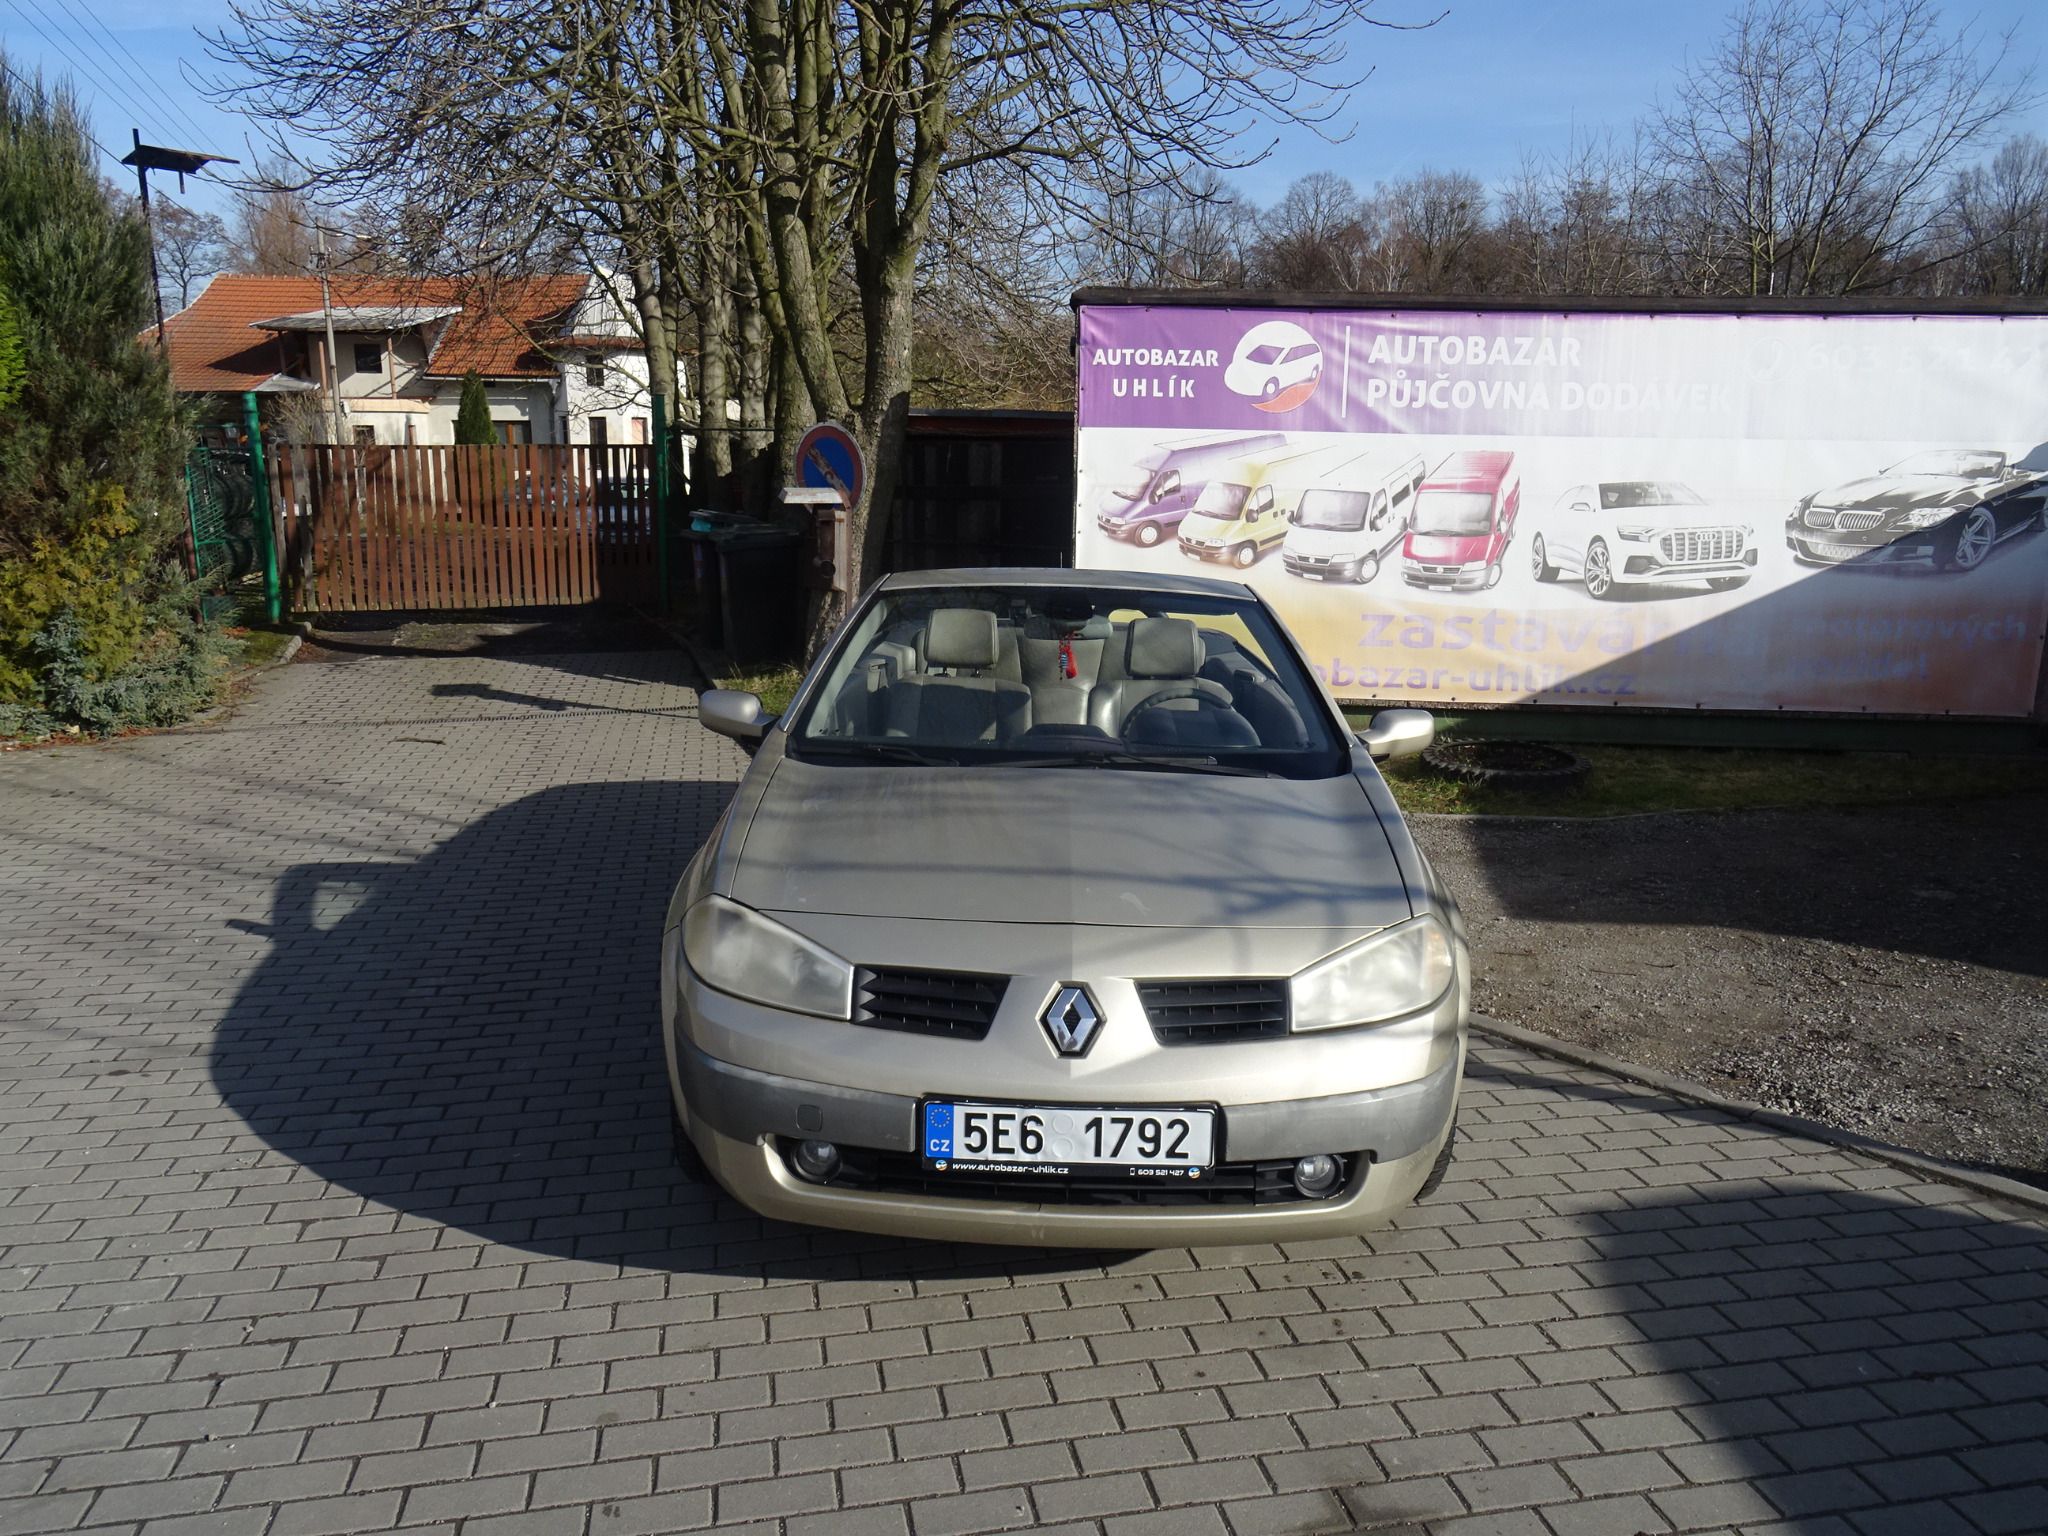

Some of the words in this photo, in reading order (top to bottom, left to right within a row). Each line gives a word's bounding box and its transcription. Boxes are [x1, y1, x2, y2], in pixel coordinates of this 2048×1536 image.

[1092, 348, 1220, 367] AUTOBAZAR
[1367, 335, 1581, 367] AUTOBAZAR
[1113, 374, 1195, 398] UHLÍK
[1366, 368, 1550, 410] PŮJČOVNA
[1560, 375, 1732, 413] DODÁVEK
[930, 1139, 950, 1152] CZ
[964, 1112, 1044, 1155] 5E6
[1085, 1116, 1190, 1159] 1792
[952, 1162, 1069, 1174] www.autobazar-uhlik.cz
[1137, 1168, 1154, 1176] 603
